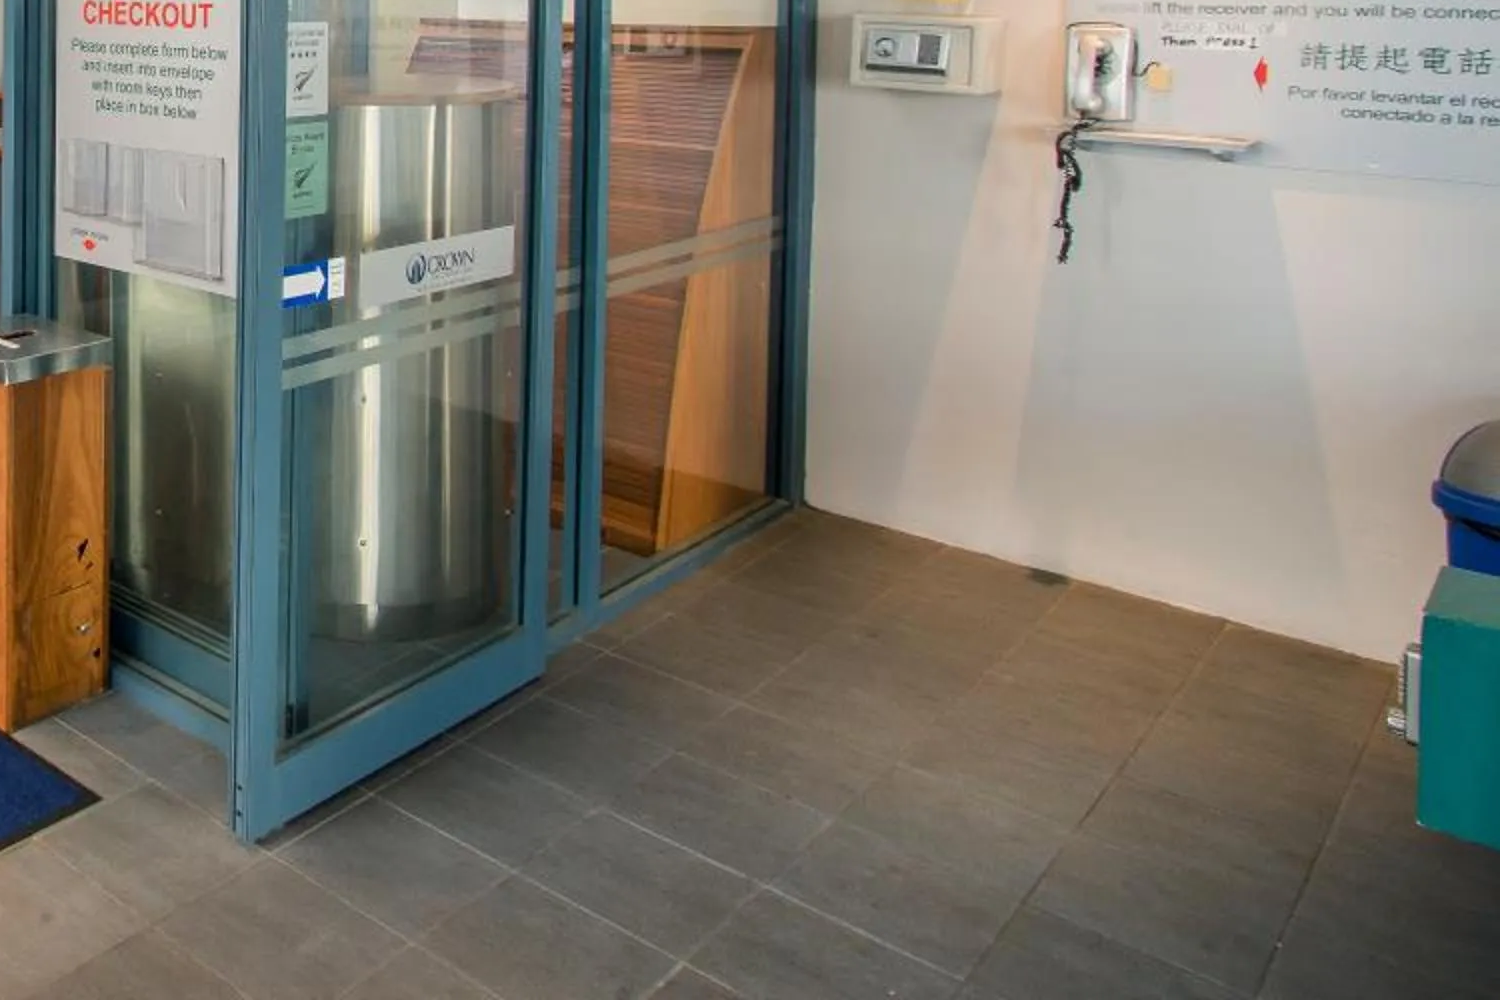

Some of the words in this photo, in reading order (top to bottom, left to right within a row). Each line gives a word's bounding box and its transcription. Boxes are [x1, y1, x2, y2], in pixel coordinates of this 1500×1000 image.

[83, 0, 214, 29] CHECKOUT
[1167, 2, 1194, 14] the
[1198, 2, 1268, 16] receiver
[1272, 3, 1308, 18] and
[1313, 6, 1348, 20] you
[1354, 4, 1385, 17] will
[1390, 4, 1417, 19] be
[70, 36, 107, 54] Please
[109, 41, 159, 58] complete
[161, 42, 189, 58] form
[191, 44, 228, 60] below
[159, 65, 215, 81] envelope
[115, 81, 143, 94] room
[146, 82, 173, 101] keys
[175, 84, 202, 101] then
[1287, 85, 1318, 101] Por
[1322, 87, 1366, 102] favor
[1371, 89, 1444, 106] levantar
[1449, 93, 1466, 107] el
[95, 98, 124, 114] place
[125, 99, 137, 114] in
[139, 101, 159, 117] box
[163, 104, 197, 120] below
[1340, 106, 1435, 124] conectado
[1439, 112, 1452, 125] a
[1457, 111, 1475, 127] la
